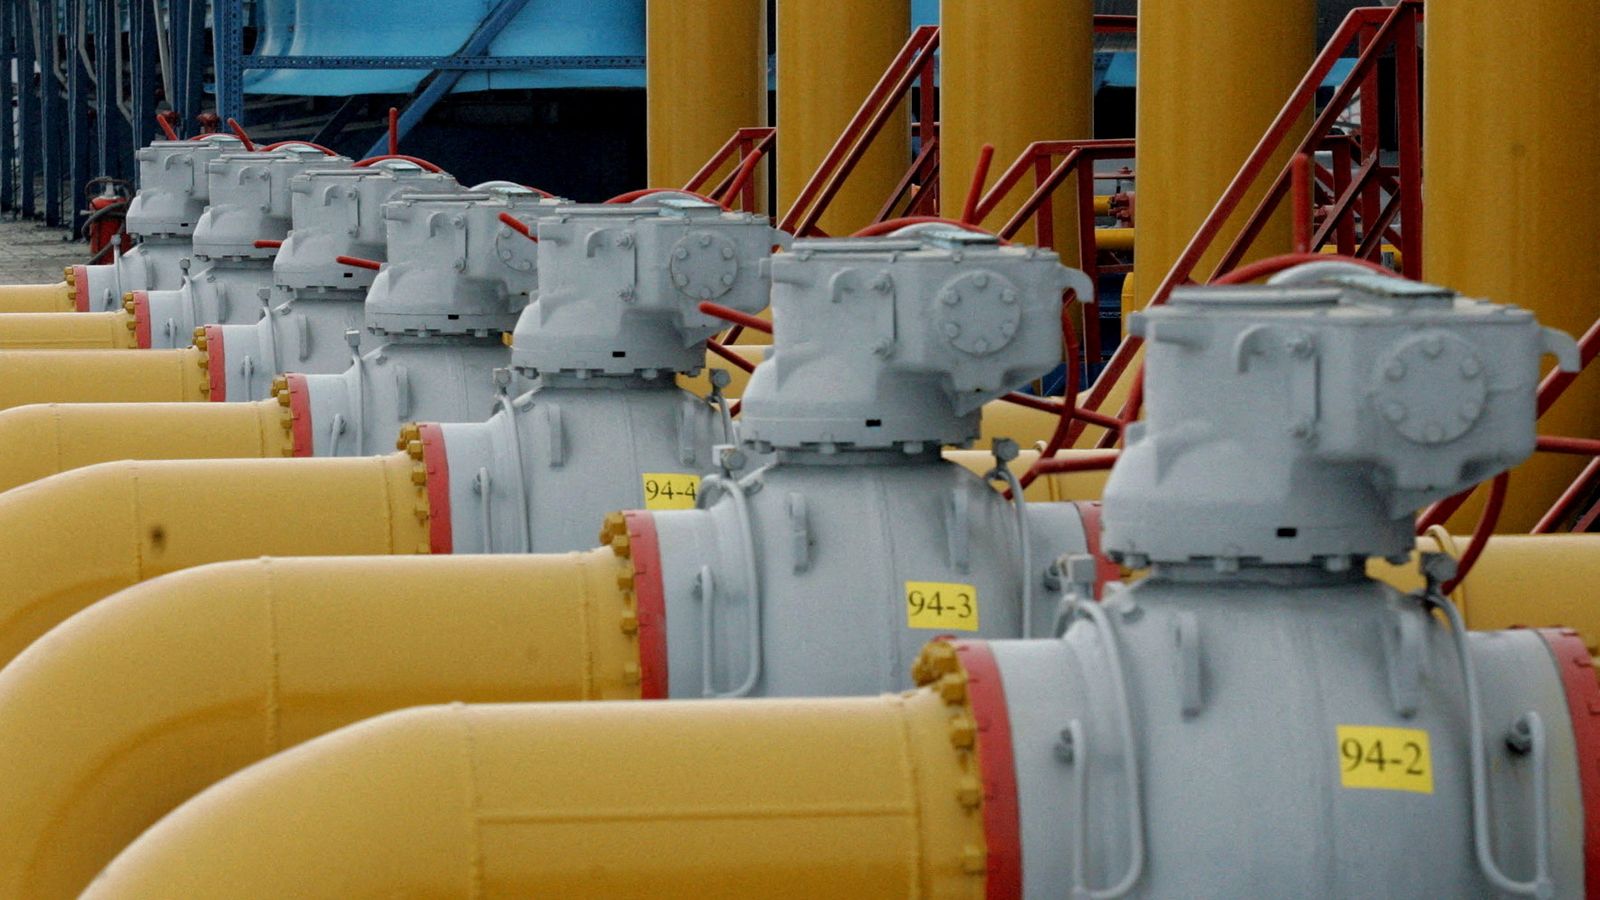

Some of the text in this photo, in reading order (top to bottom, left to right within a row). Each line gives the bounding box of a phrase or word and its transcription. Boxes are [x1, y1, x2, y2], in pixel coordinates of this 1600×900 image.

[646, 480, 697, 501] 94-4
[909, 591, 972, 618] 94-3
[1342, 738, 1424, 776] 94-2
